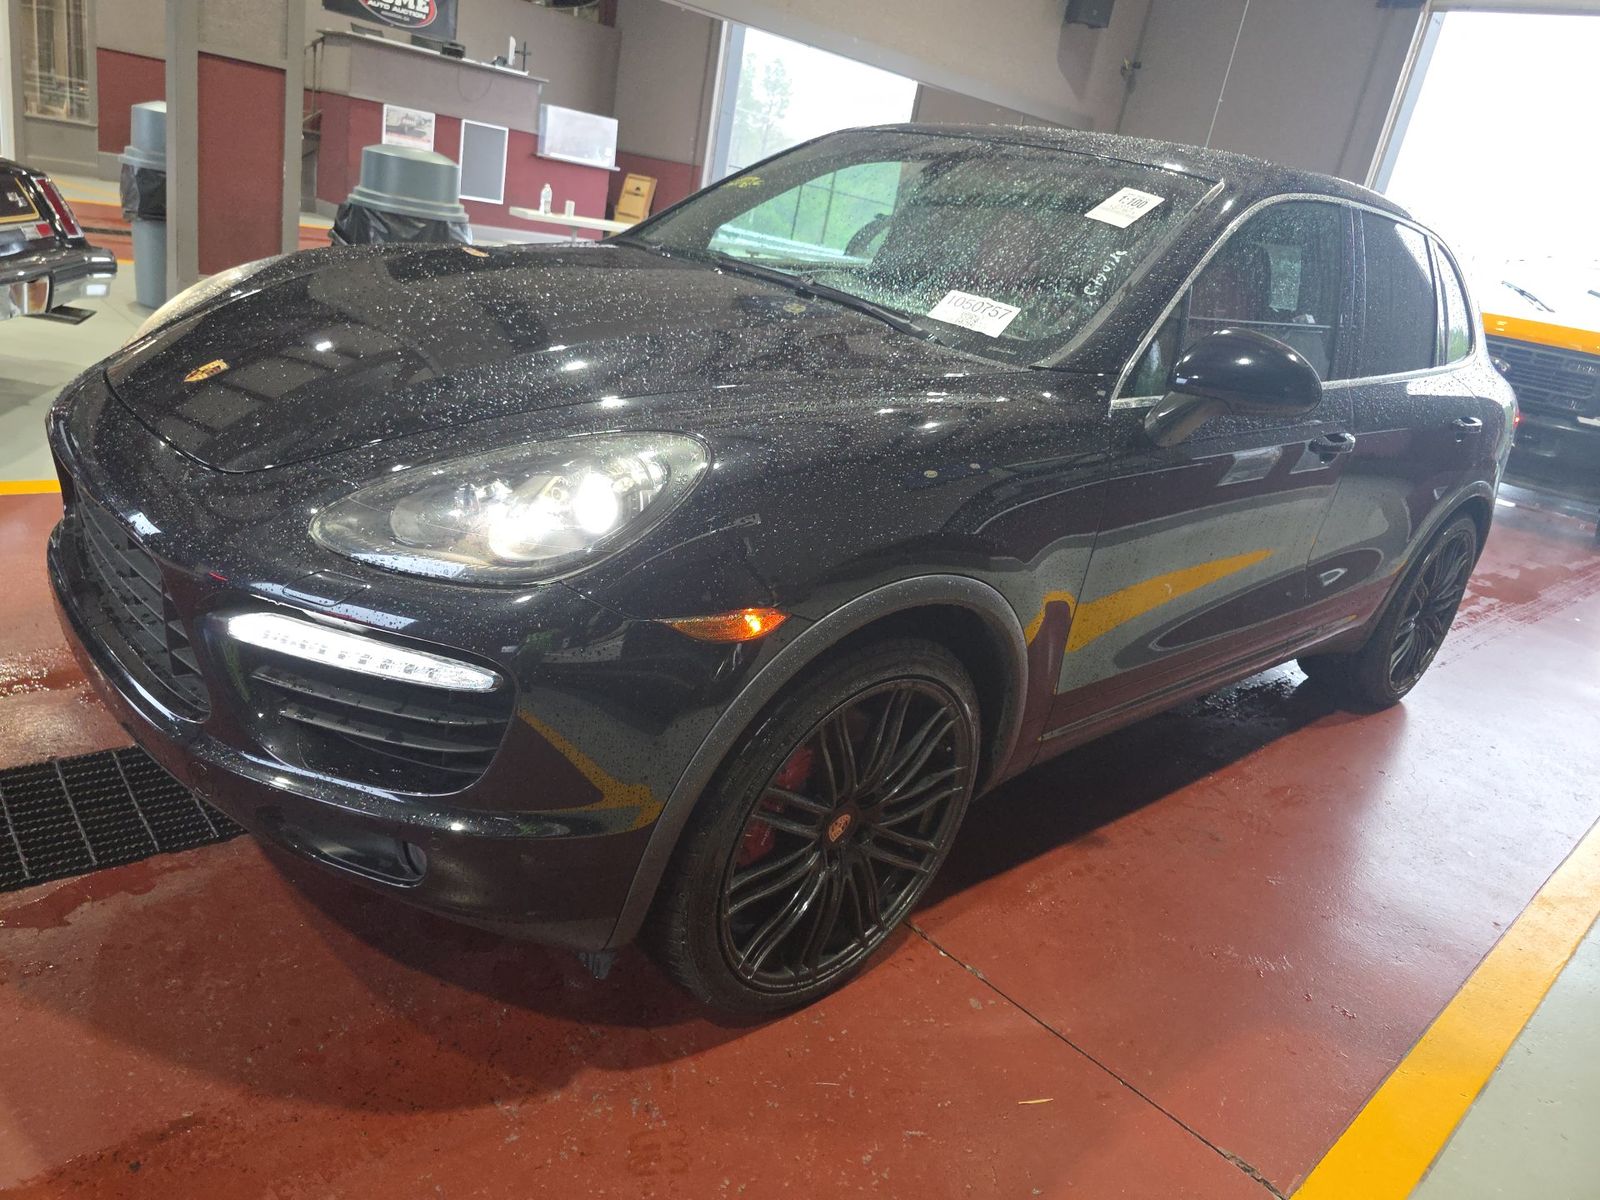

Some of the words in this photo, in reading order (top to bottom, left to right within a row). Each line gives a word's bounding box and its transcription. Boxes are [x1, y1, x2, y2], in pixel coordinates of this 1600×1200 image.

[367, 0, 391, 10] AUTO
[391, 5, 427, 19] AUCTION
[947, 295, 1013, 320] 1050757
